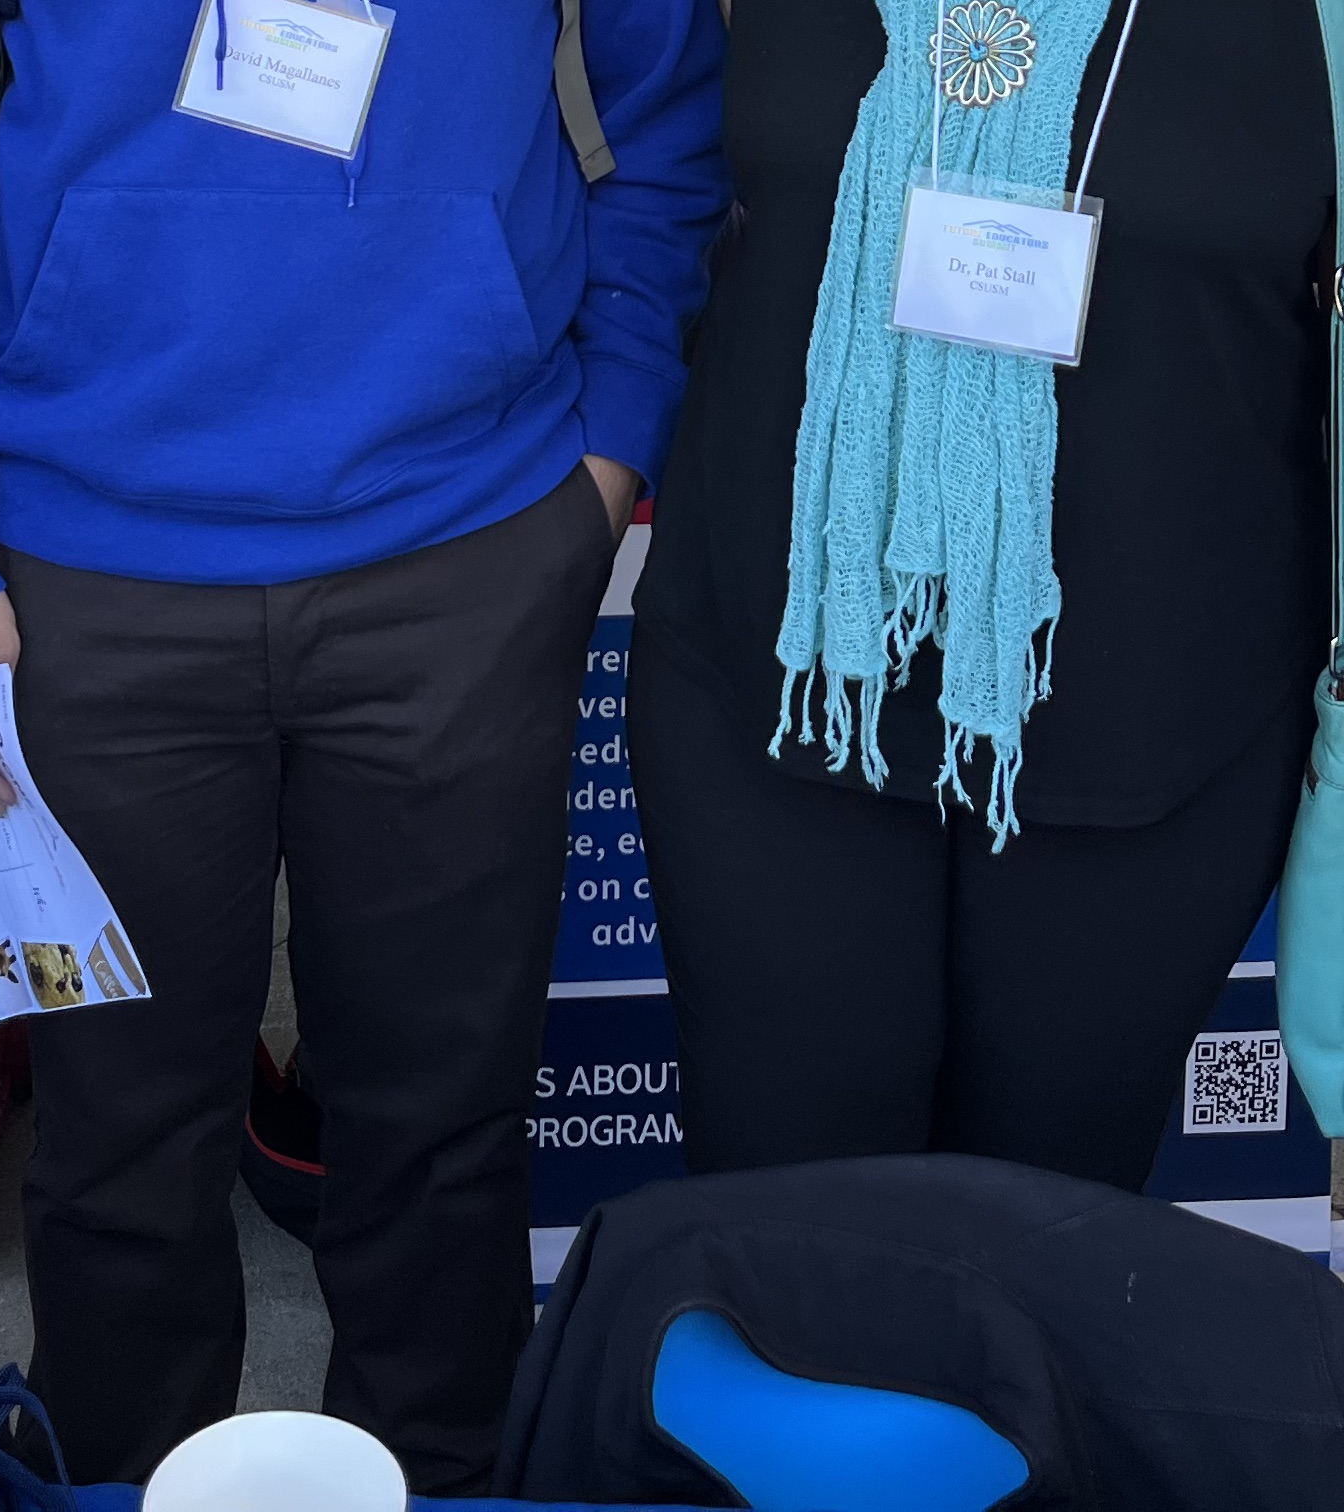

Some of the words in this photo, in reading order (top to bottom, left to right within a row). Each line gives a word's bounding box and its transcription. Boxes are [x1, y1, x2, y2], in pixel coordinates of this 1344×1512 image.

[948, 257, 970, 275] Dr.
[975, 262, 998, 279] Pat
[1002, 266, 1036, 286] Stall
[969, 280, 1009, 297] CSUSM
[566, 780, 637, 810] den
[578, 878, 621, 900] on
